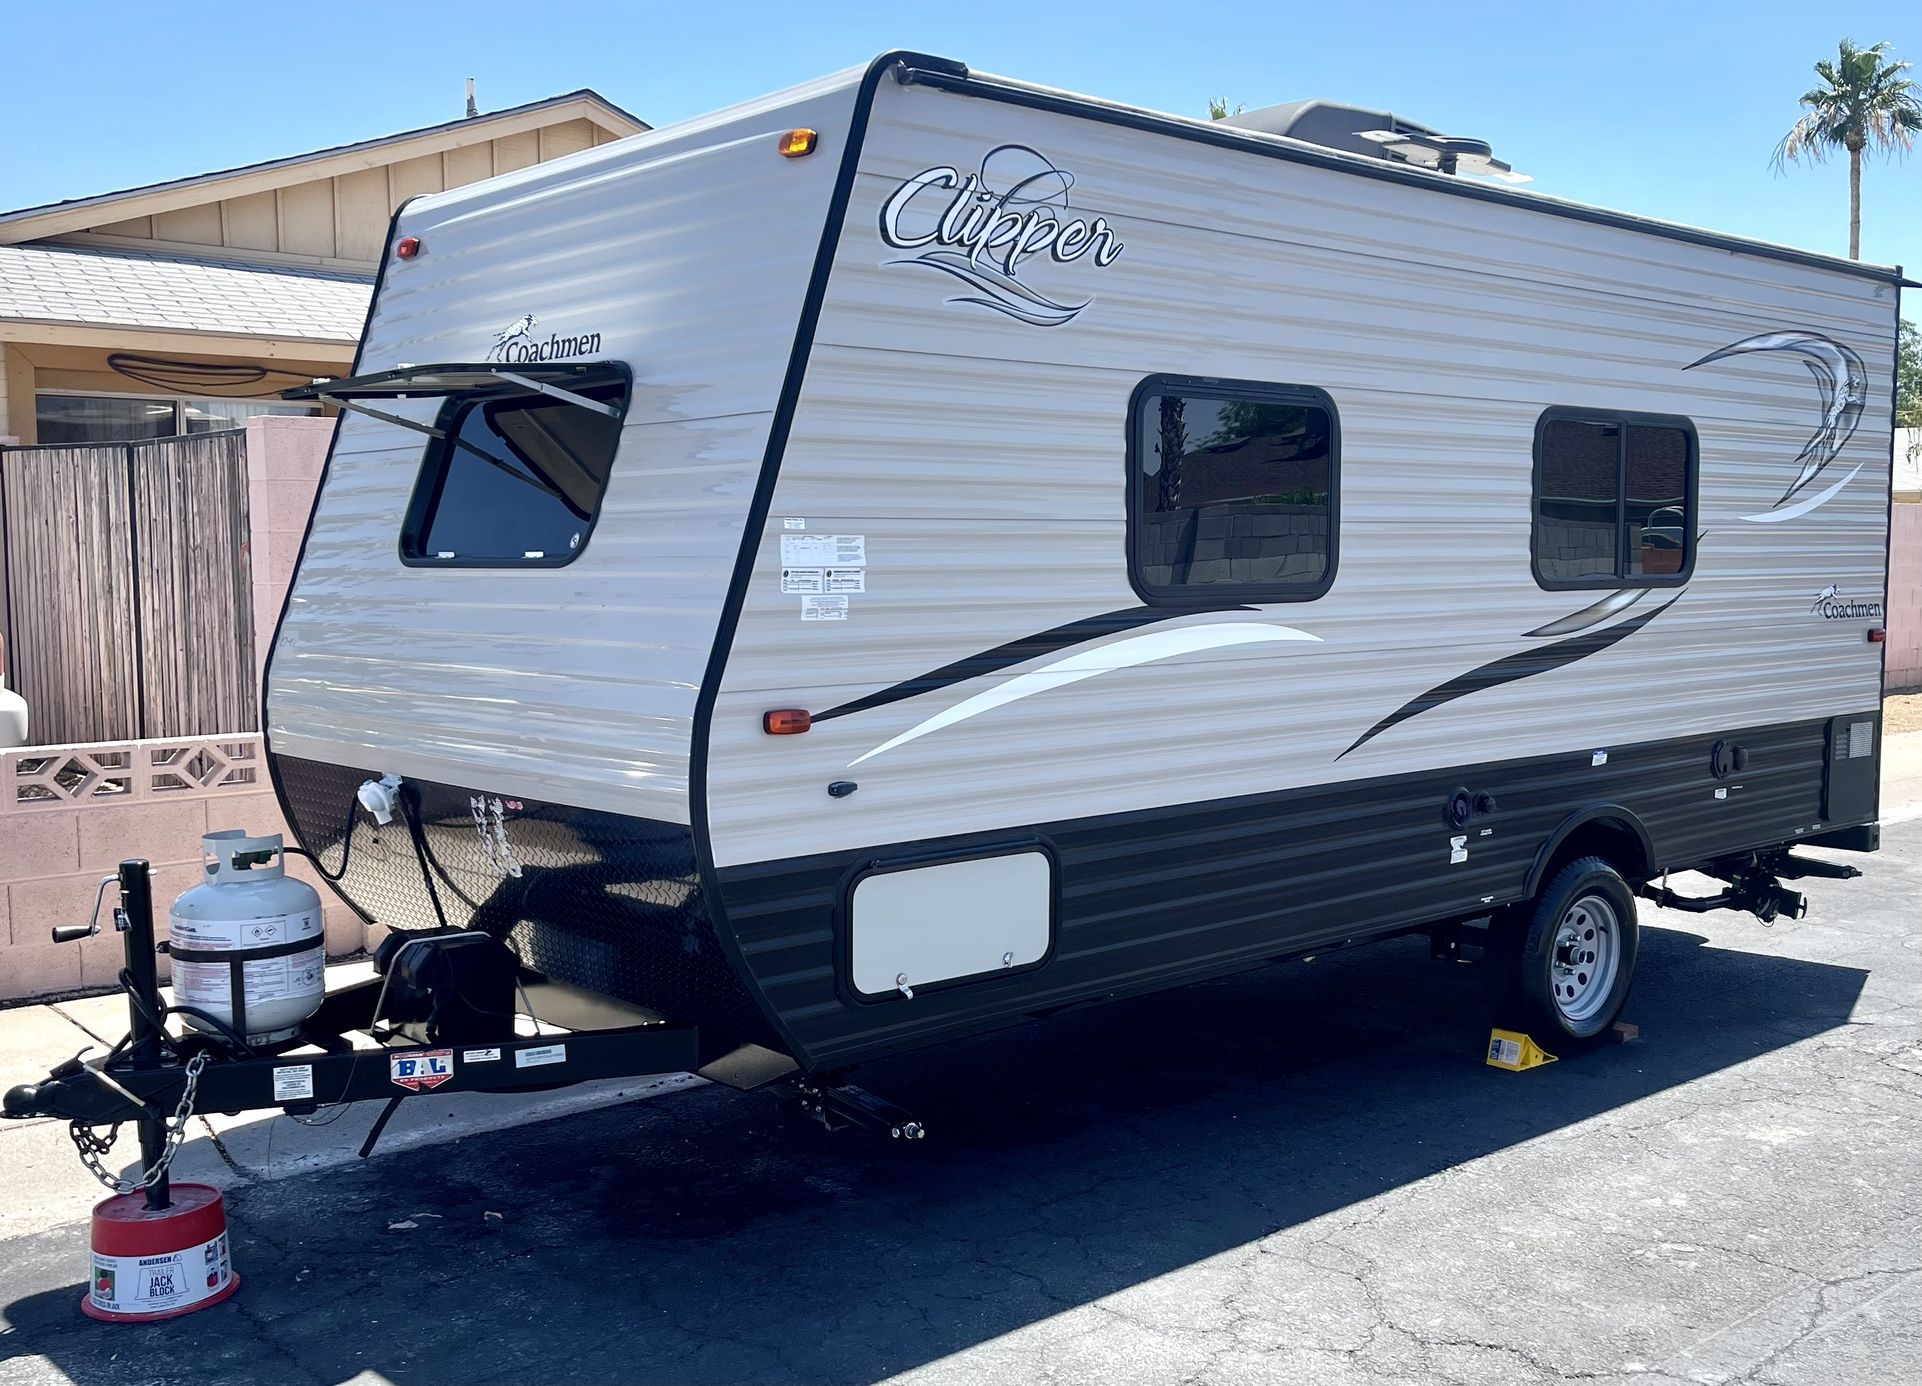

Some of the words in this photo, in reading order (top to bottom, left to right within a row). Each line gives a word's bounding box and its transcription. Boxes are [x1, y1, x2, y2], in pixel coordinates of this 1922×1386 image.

[879, 166, 1124, 276] Clipper
[505, 332, 601, 363] Coachmen
[1823, 599, 1881, 619] Coachmen
[398, 1058, 447, 1076] BAL
[138, 1256, 172, 1266] ANDERSEN
[150, 1274, 173, 1288] JACK
[150, 1285, 175, 1297] BLOCK
